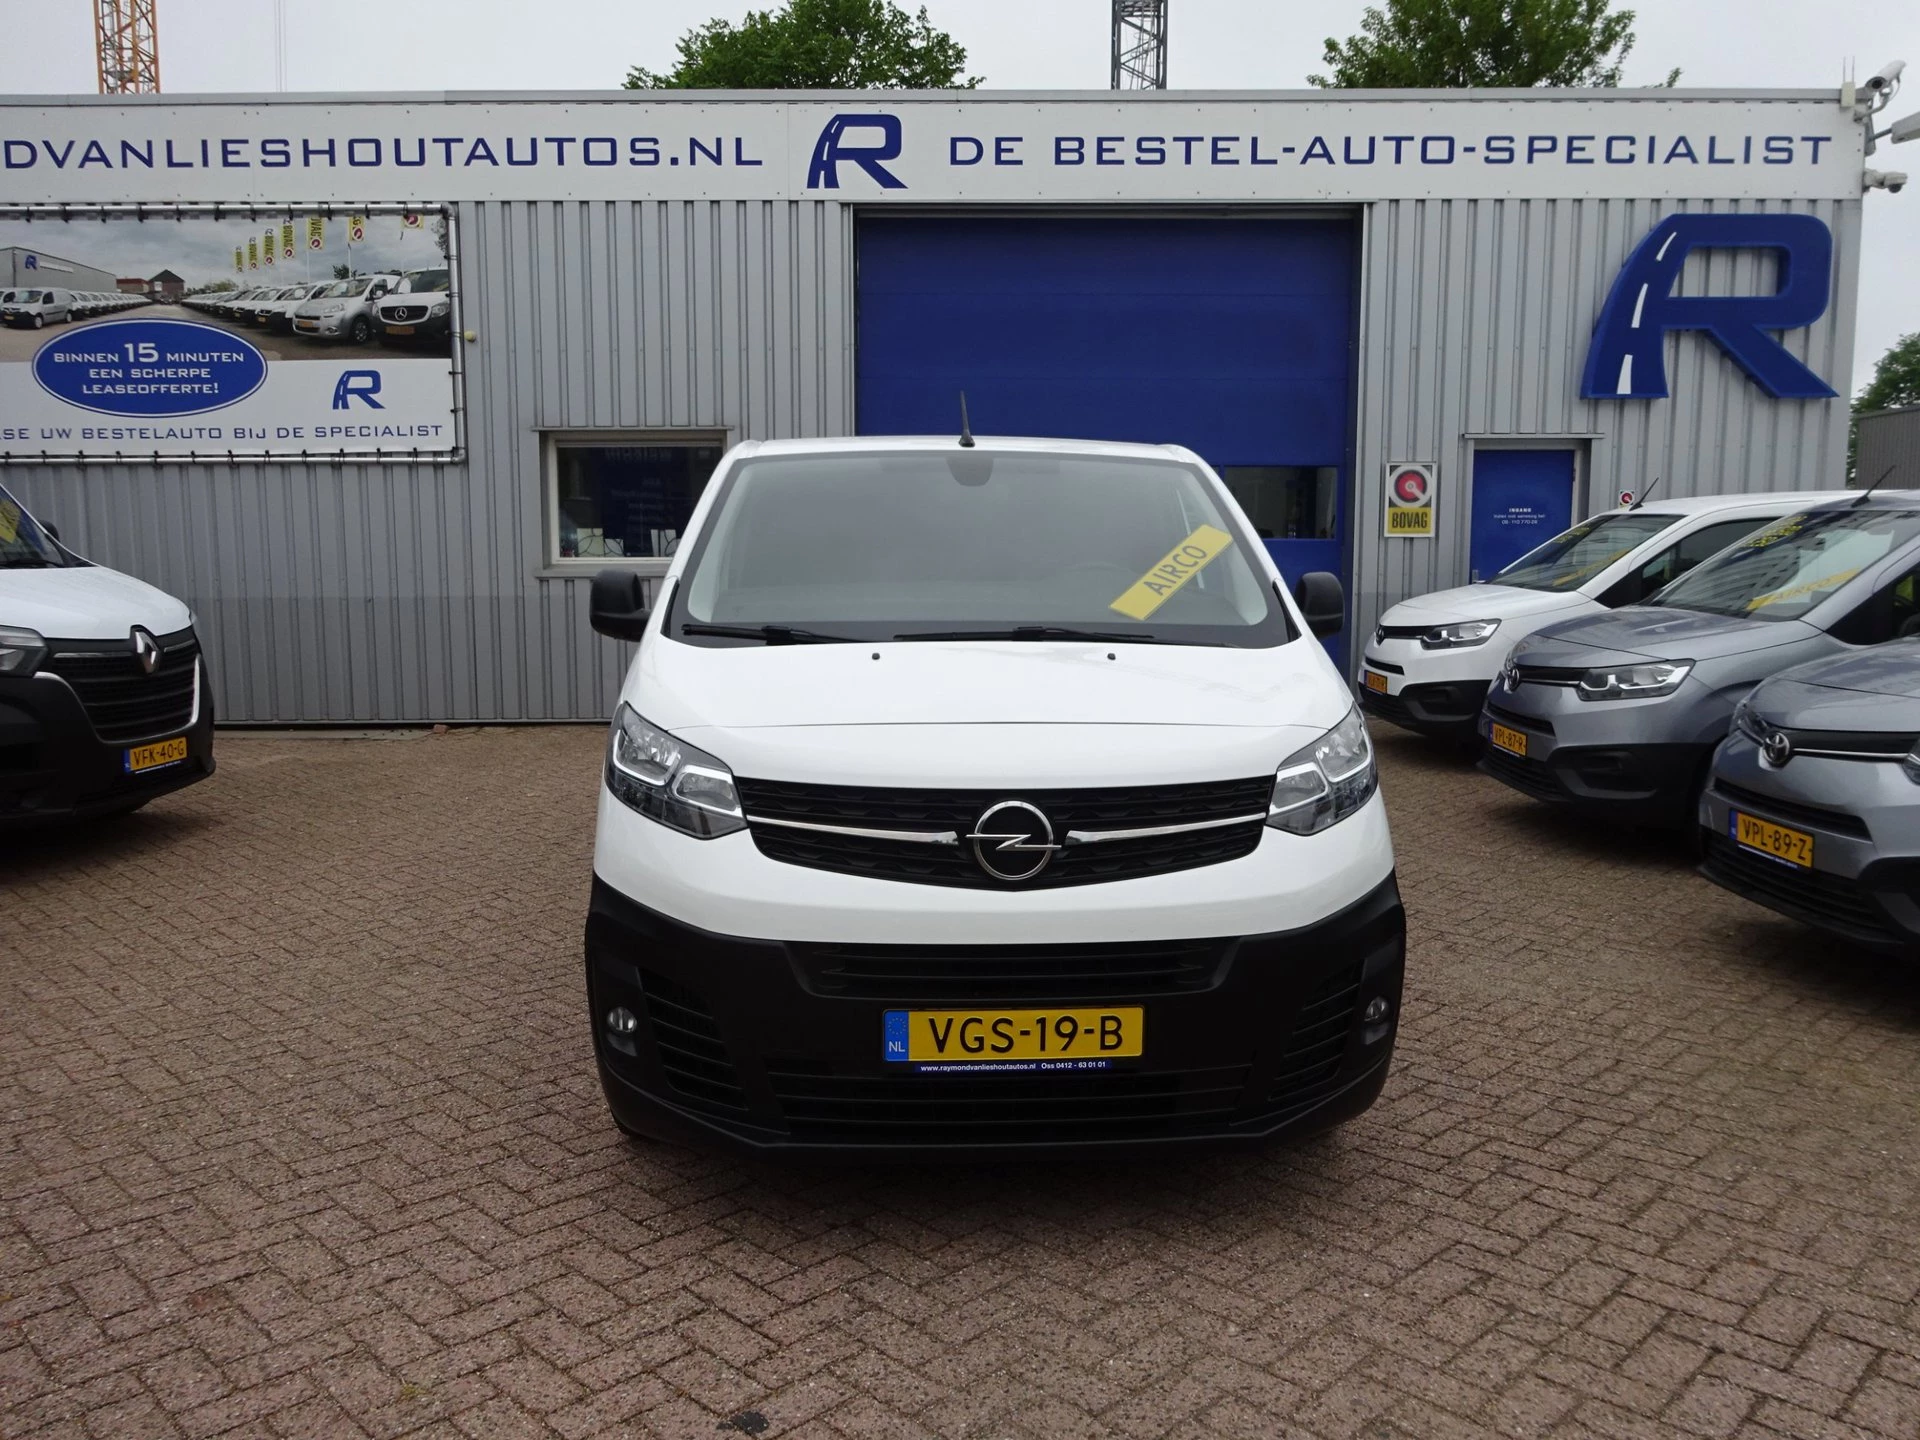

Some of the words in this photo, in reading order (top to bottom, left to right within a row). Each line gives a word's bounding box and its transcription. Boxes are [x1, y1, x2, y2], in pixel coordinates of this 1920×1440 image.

[3, 137, 763, 169] DVANLIESHOUTAUTOS.NL
[806, 114, 909, 189] R
[949, 136, 1024, 166] DE
[1054, 135, 1832, 166] BESTEL-AUTO-SPECIALIST
[1579, 213, 1840, 400] R
[53, 352, 119, 363] BINNEN
[124, 342, 160, 363] 15
[166, 352, 244, 362] MINUTEN
[82, 381, 220, 394] LEASEOFFERTE!
[89, 368, 123, 379] EEN
[130, 368, 212, 378] SCHERPE
[0, 428, 30, 440] SE
[40, 427, 73, 440] UW
[81, 427, 223, 440] BESTELAUTO
[233, 427, 266, 439] BIJ
[276, 426, 305, 438] DE
[314, 424, 443, 438] SPECIALIST
[1391, 511, 1428, 529] BOVAG
[1143, 545, 1208, 597] AIRCO
[133, 741, 183, 766] VFK-40-G
[1742, 819, 1807, 861] VPL-89-Z
[888, 1041, 906, 1052] NL
[927, 1014, 1124, 1054] VGS-19-B
[920, 1063, 1037, 1073] www.raymondvanlieshoutautos.nl
[1041, 1062, 1055, 1070] Oss
[1056, 1061, 1073, 1070] 0412
[1078, 1061, 1087, 1069] 63
